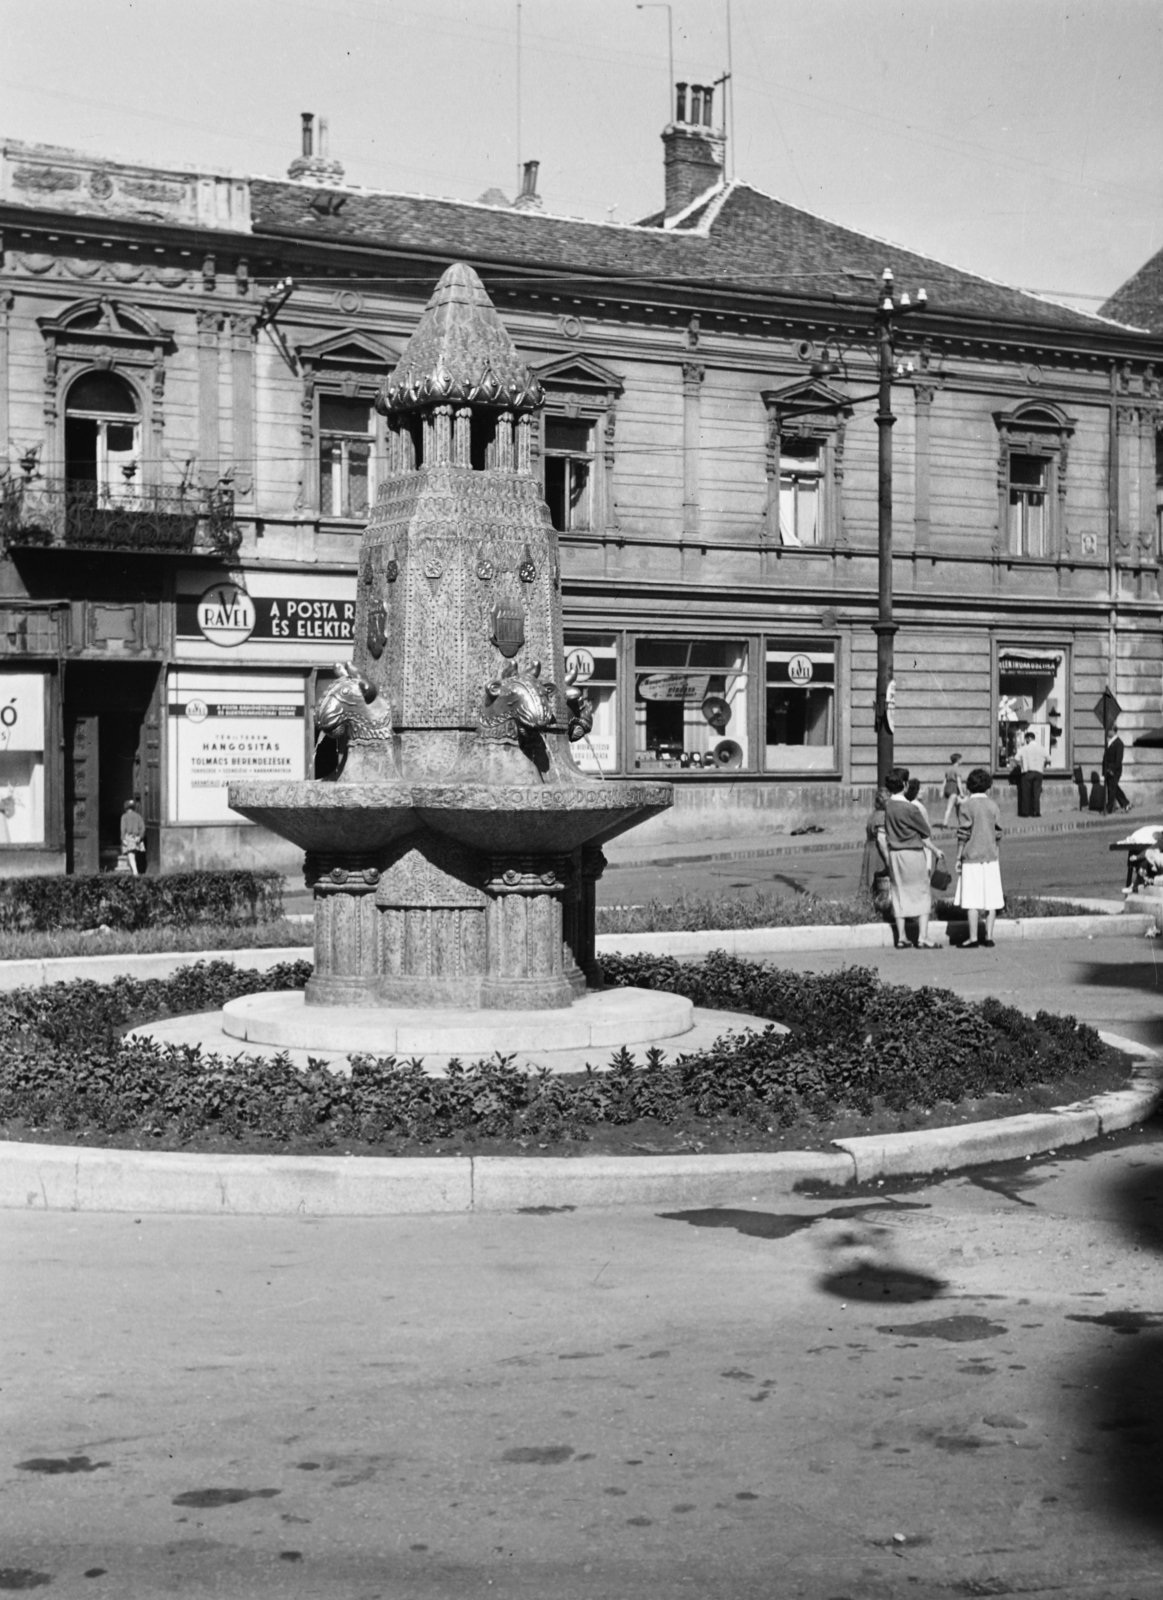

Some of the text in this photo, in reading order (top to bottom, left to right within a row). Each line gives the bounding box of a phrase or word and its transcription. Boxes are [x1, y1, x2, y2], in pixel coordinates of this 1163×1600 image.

[204, 591, 249, 627] RAVEL
[270, 601, 281, 618] A
[287, 601, 338, 619] POSTA
[271, 615, 356, 638] ÉS ELEKTR
[191, 756, 292, 766] TOLMÁCS BERENDEZÉSEK
